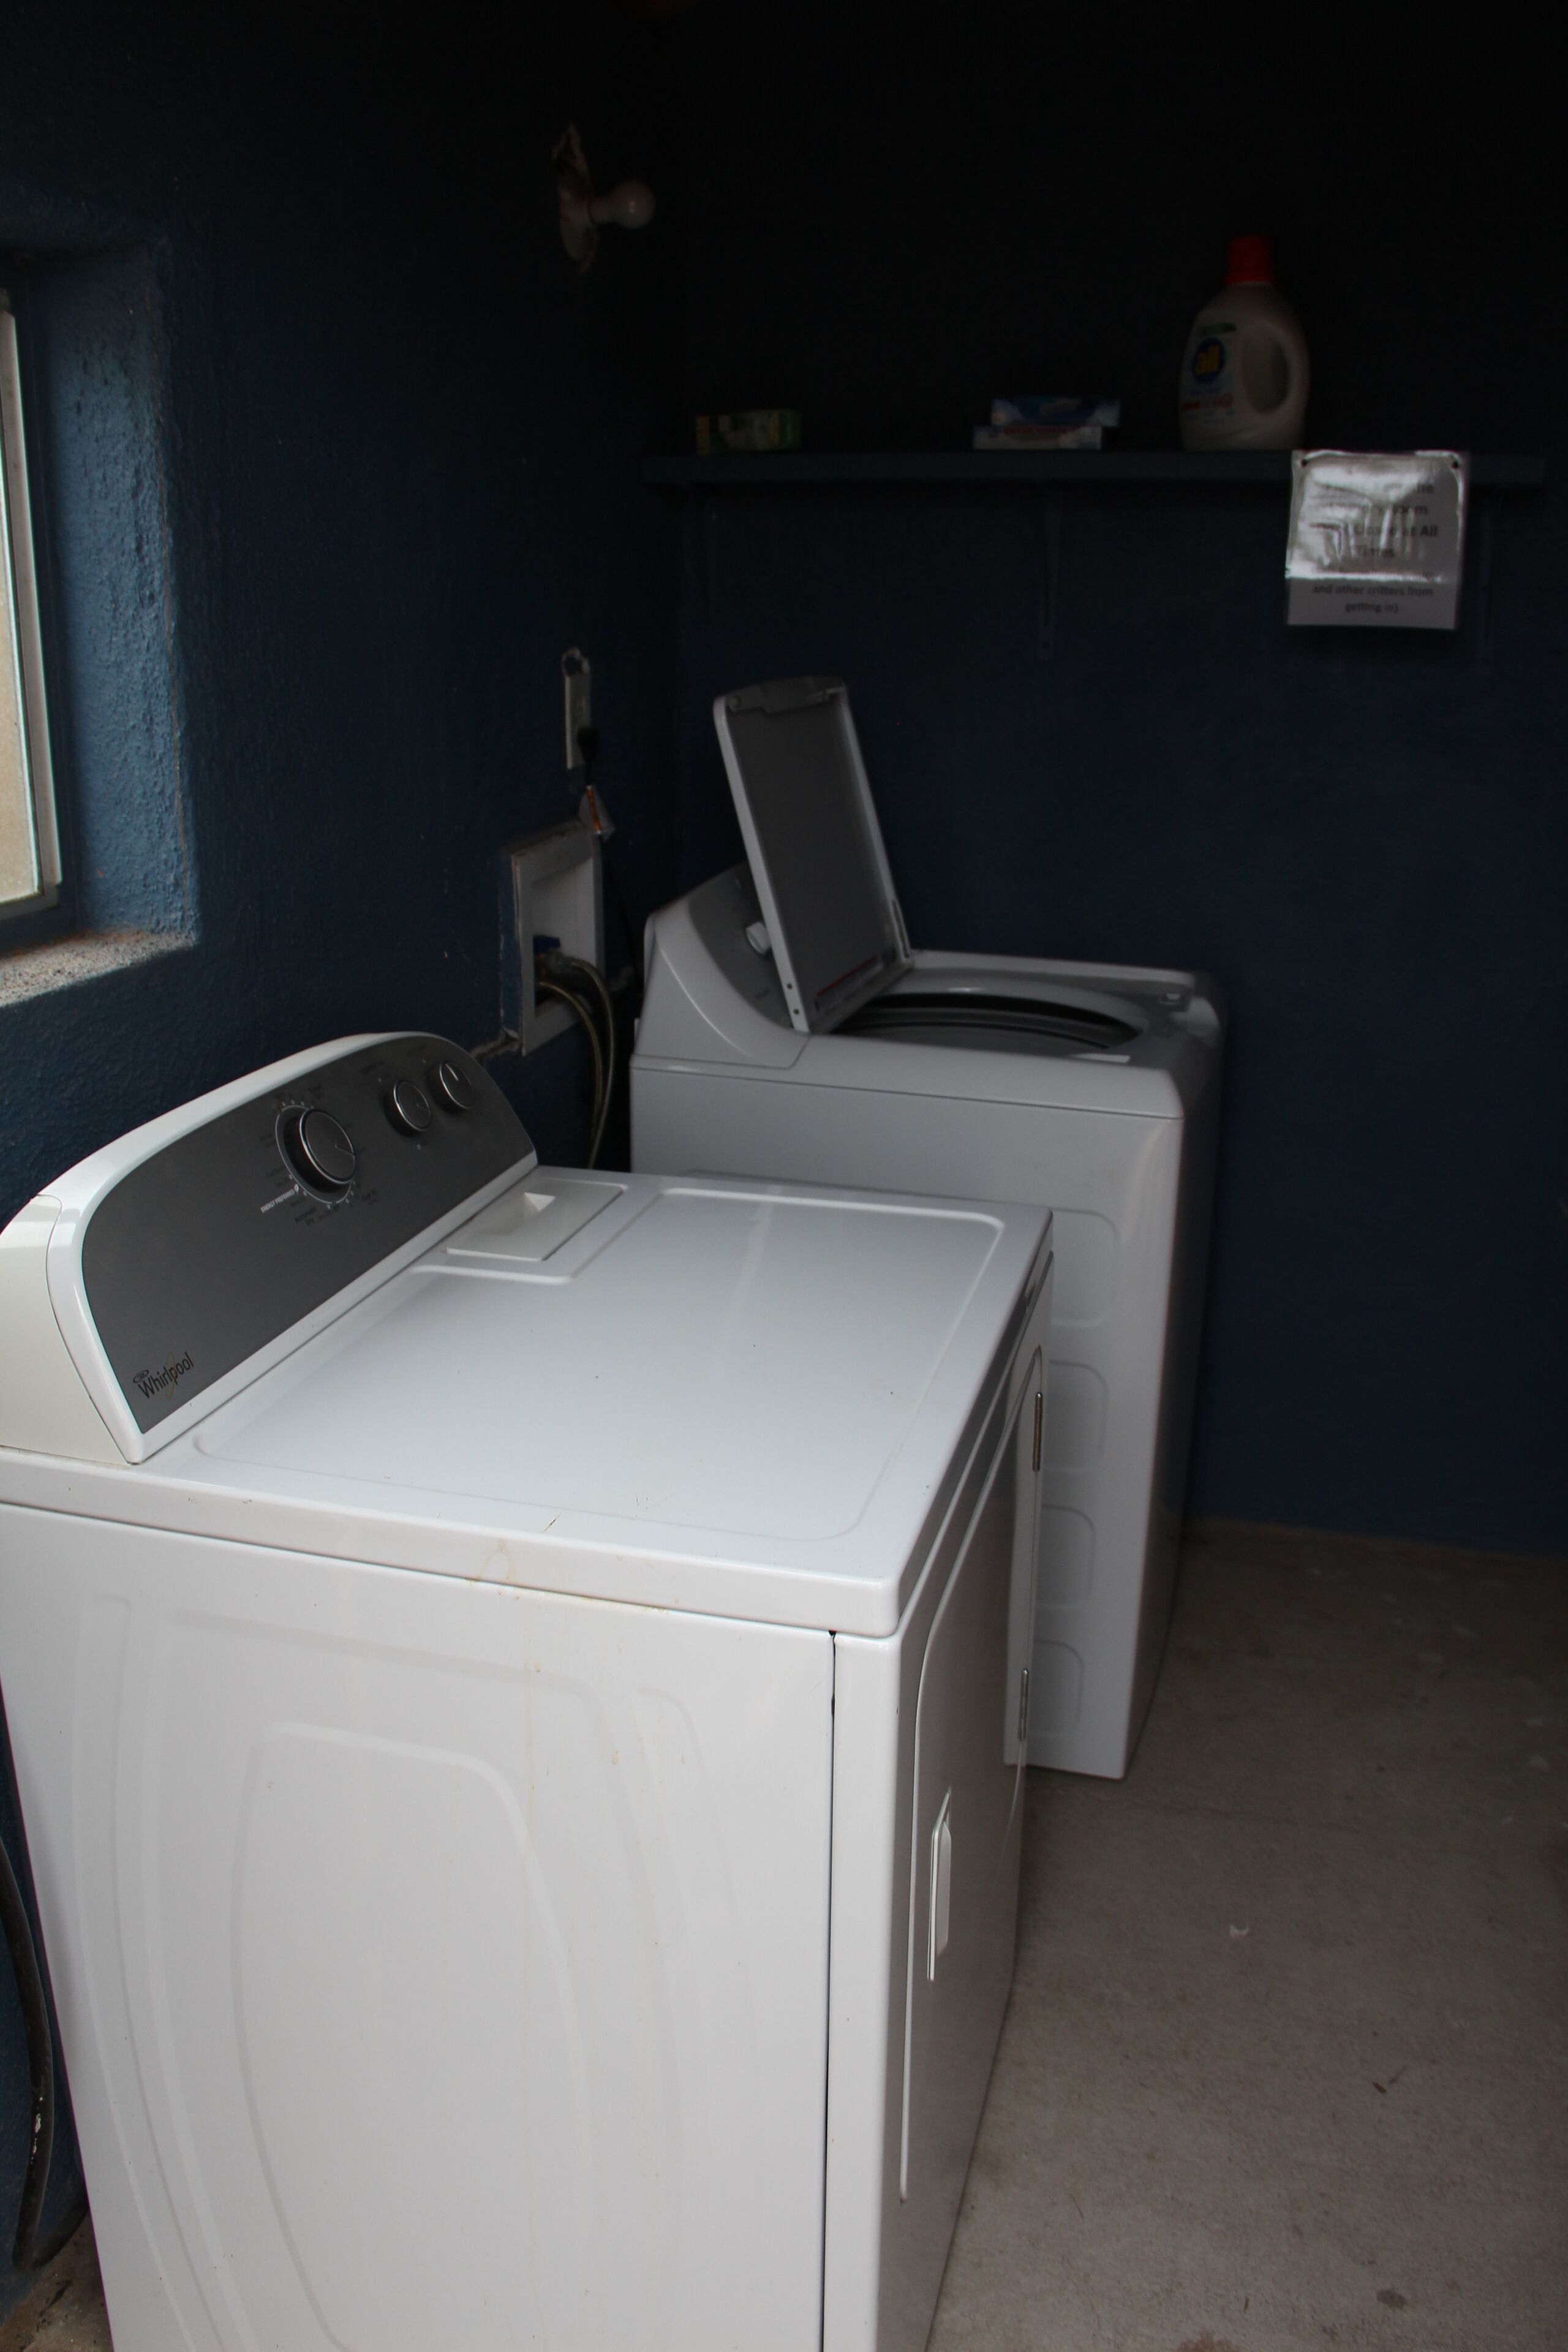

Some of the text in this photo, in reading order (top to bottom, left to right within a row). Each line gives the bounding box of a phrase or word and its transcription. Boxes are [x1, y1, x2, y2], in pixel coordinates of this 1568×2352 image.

[1195, 346, 1220, 374] all
[1420, 526, 1438, 537] All
[1313, 584, 1434, 597] and other critters from
[1344, 603, 1381, 613] getting
[138, 1351, 194, 1398] Whirlpool
